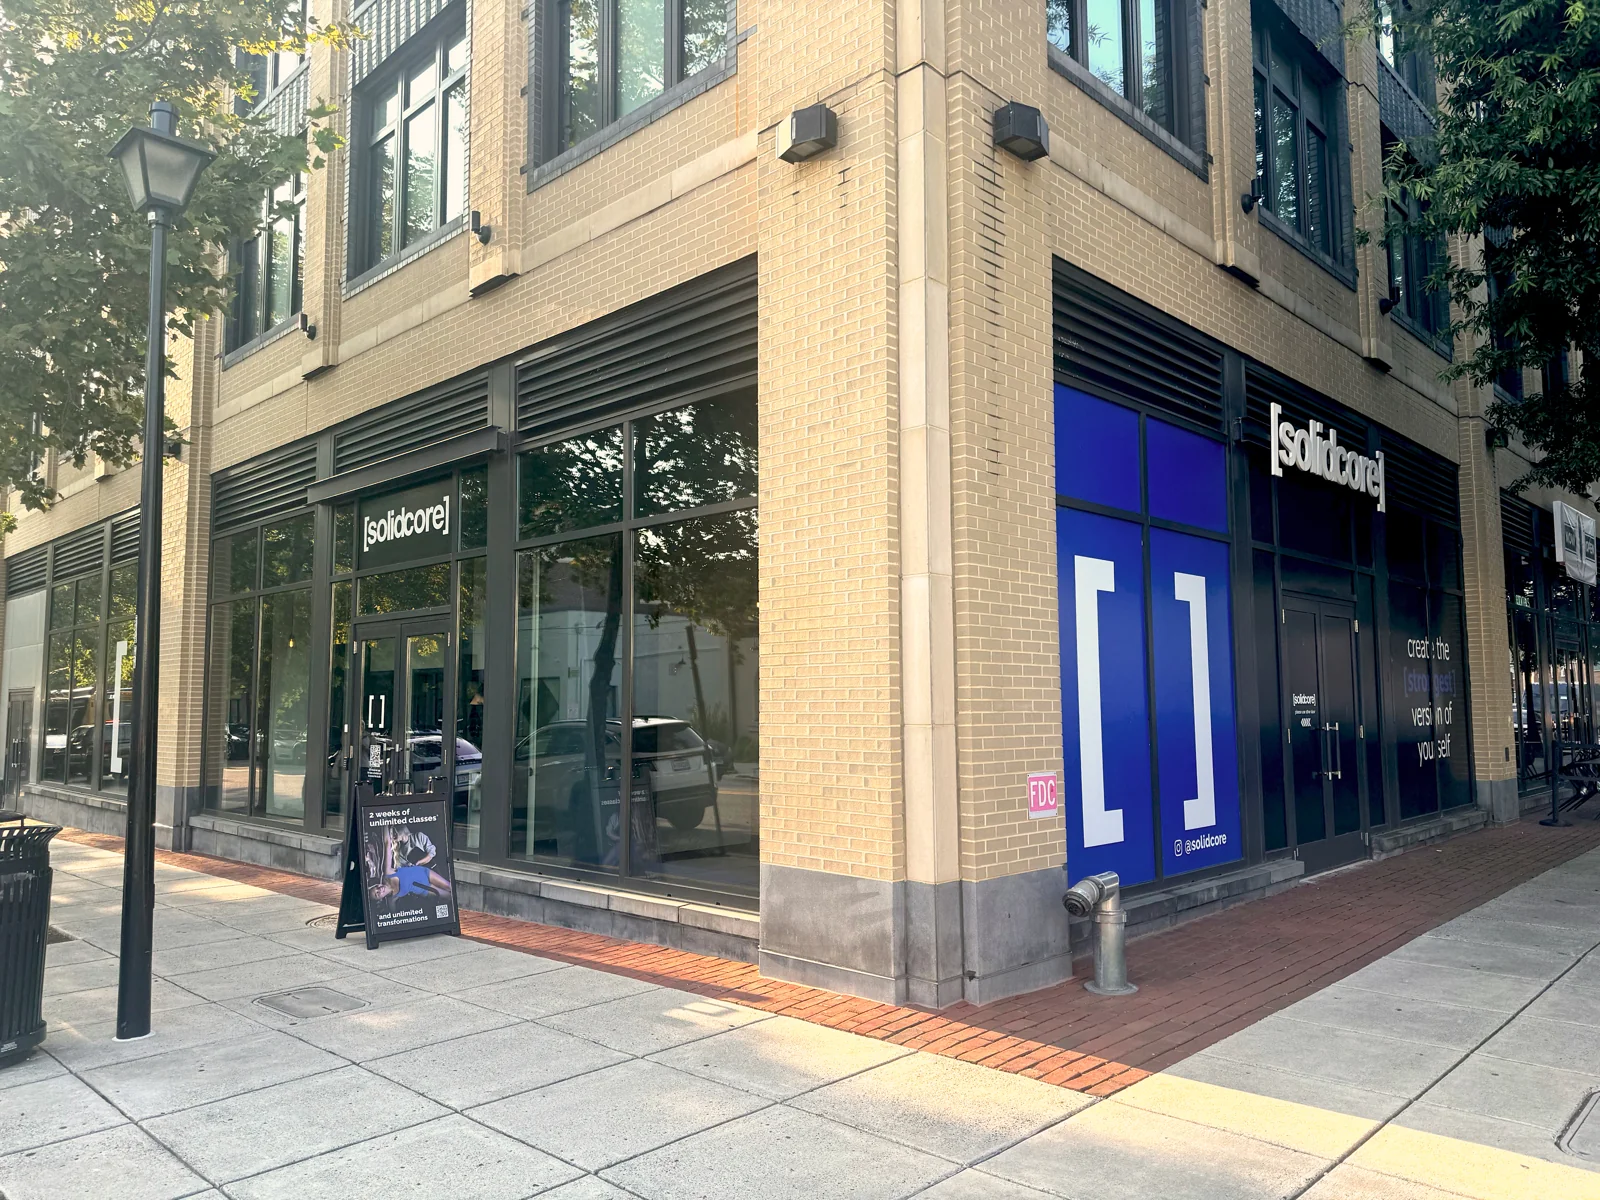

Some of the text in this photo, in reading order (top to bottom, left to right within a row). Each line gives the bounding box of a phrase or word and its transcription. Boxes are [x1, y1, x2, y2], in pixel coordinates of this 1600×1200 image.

[1270, 402, 1386, 513] [solidcore]
[363, 495, 450, 553] [solidcore]
[1436, 636, 1450, 661] the
[1411, 701, 1453, 727] versin of
[1417, 733, 1451, 768] youself
[1029, 779, 1056, 808] FDC
[369, 816, 407, 827] unlimited
[375, 809, 400, 818] weeks
[401, 808, 411, 816] of
[1184, 833, 1227, 855] @solidcore
[377, 915, 428, 928] transformations
[392, 907, 423, 919] unlimited
